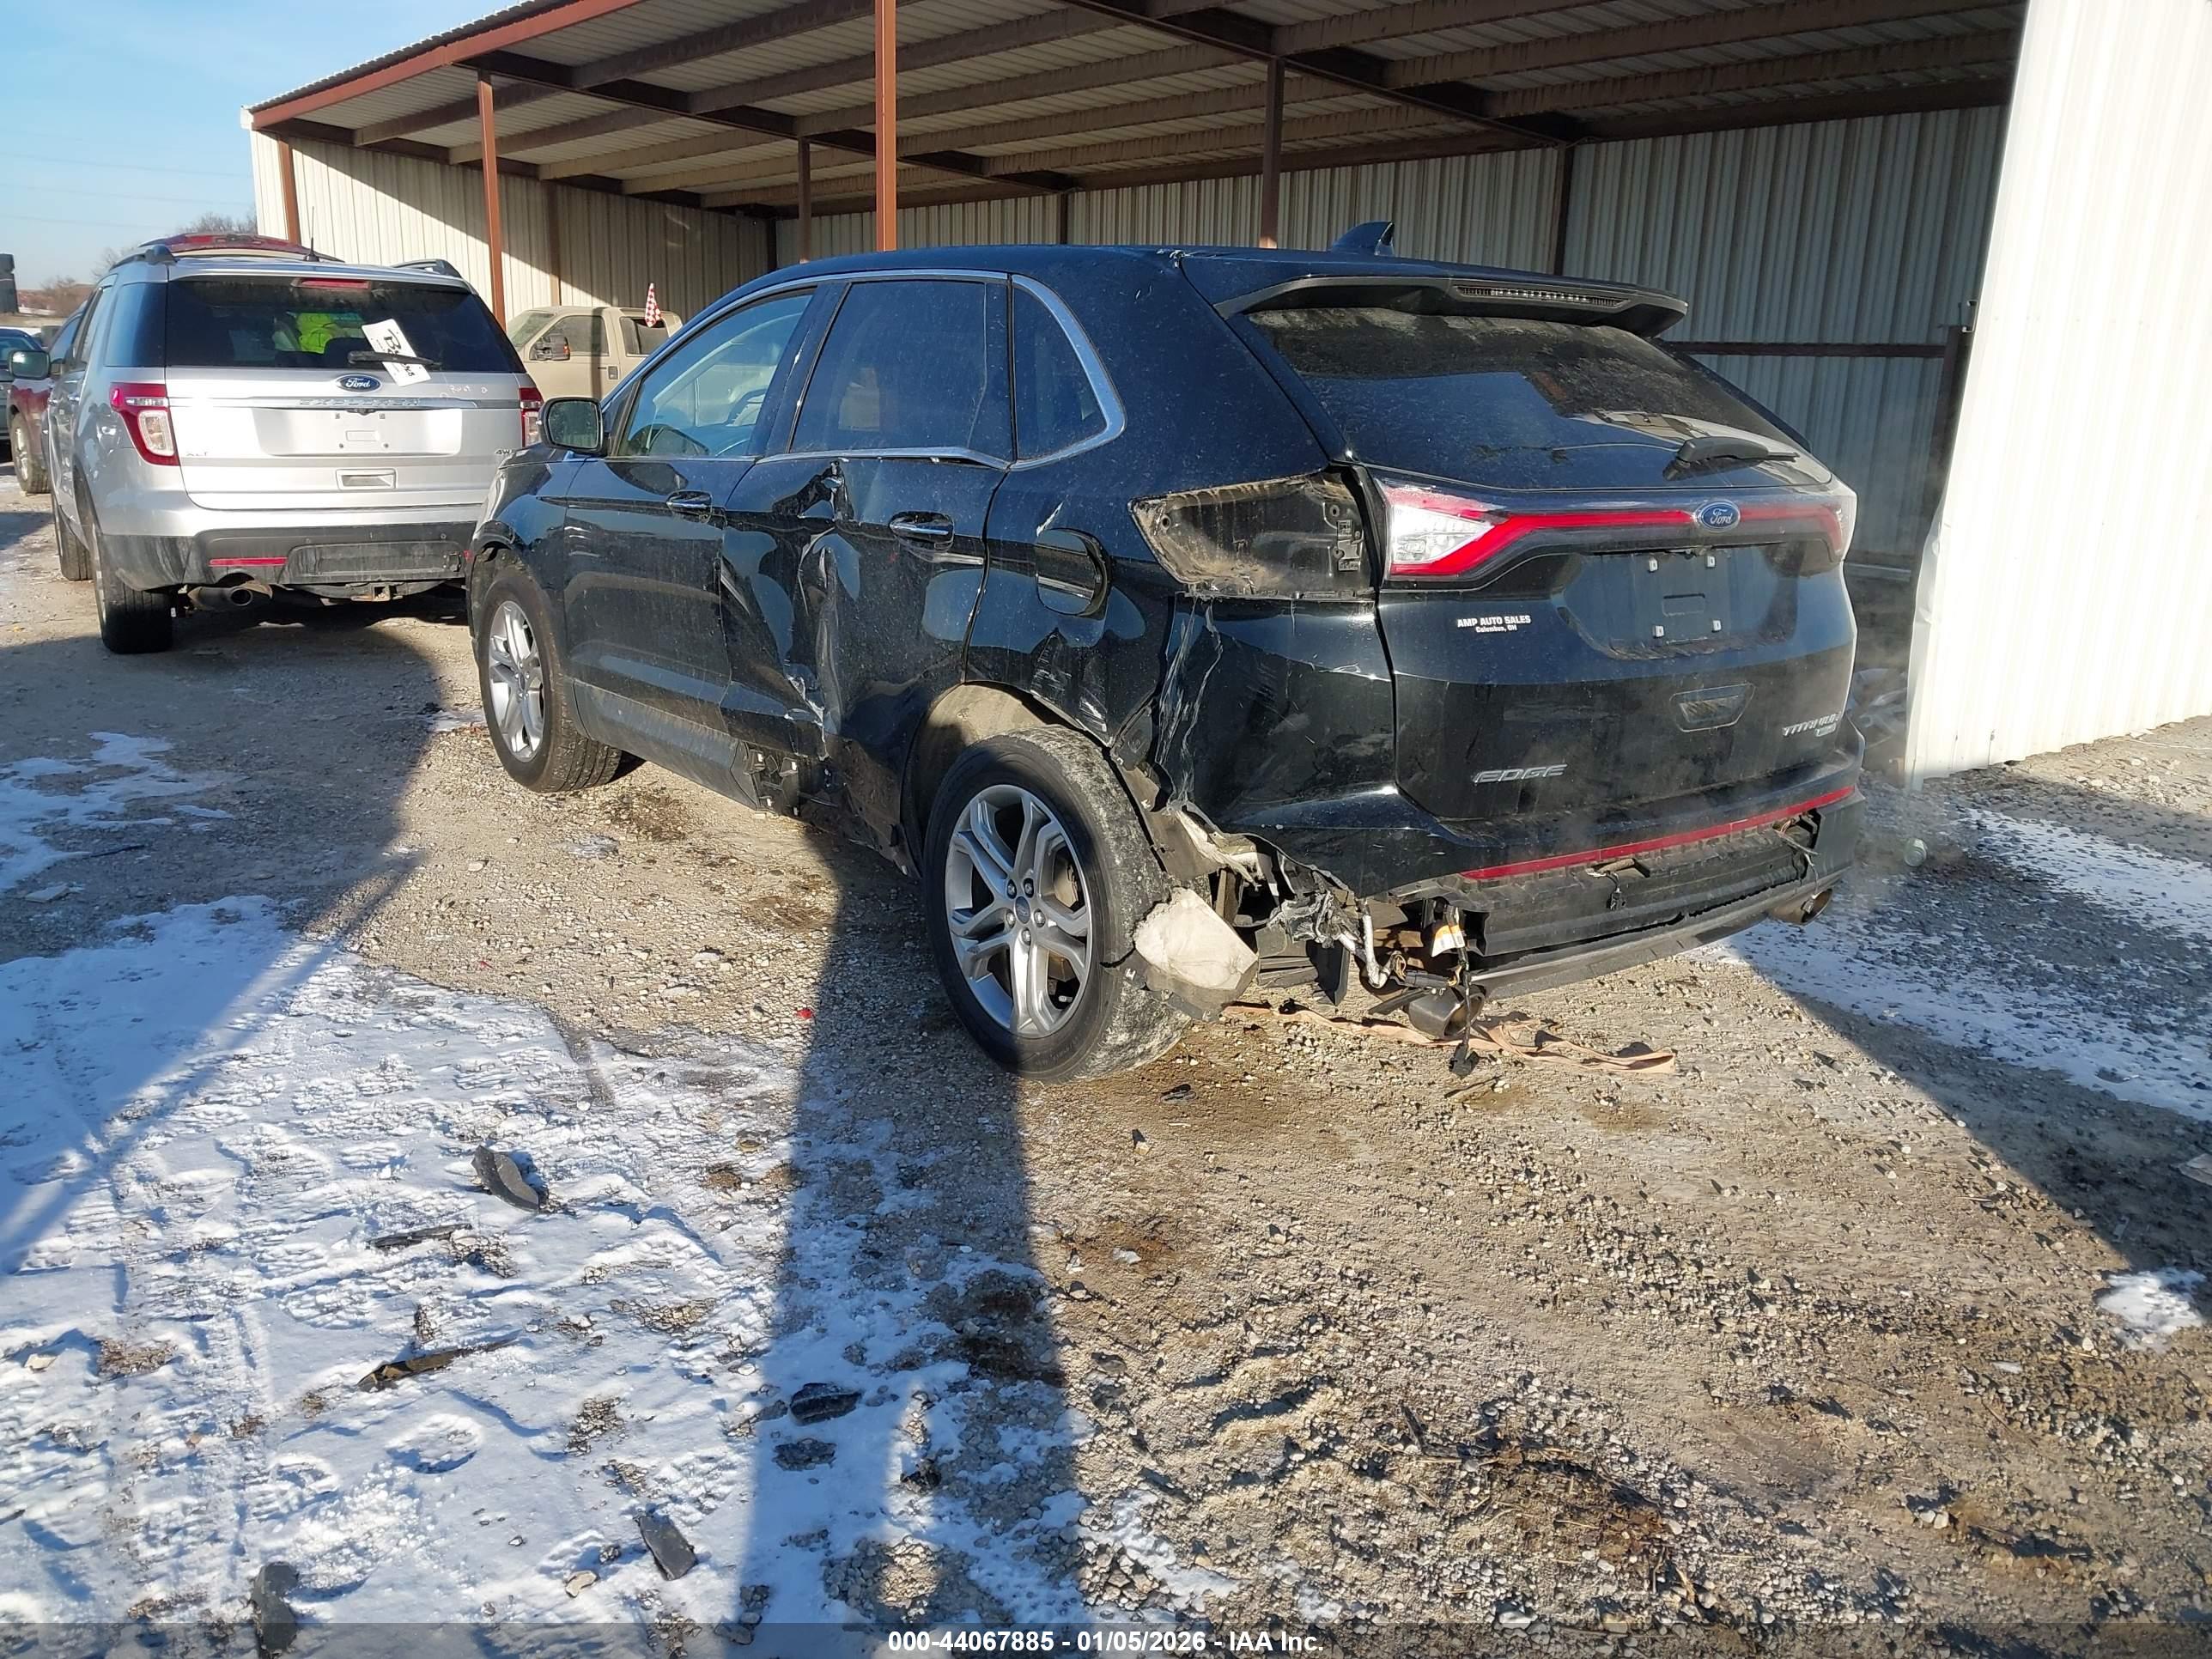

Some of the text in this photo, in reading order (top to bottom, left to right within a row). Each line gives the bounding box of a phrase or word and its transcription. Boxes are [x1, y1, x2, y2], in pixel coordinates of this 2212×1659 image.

[1710, 507, 1733, 524] Ford
[1456, 615, 1532, 628] AMP AUTO SALES
[1472, 763, 1568, 784] EDGE
